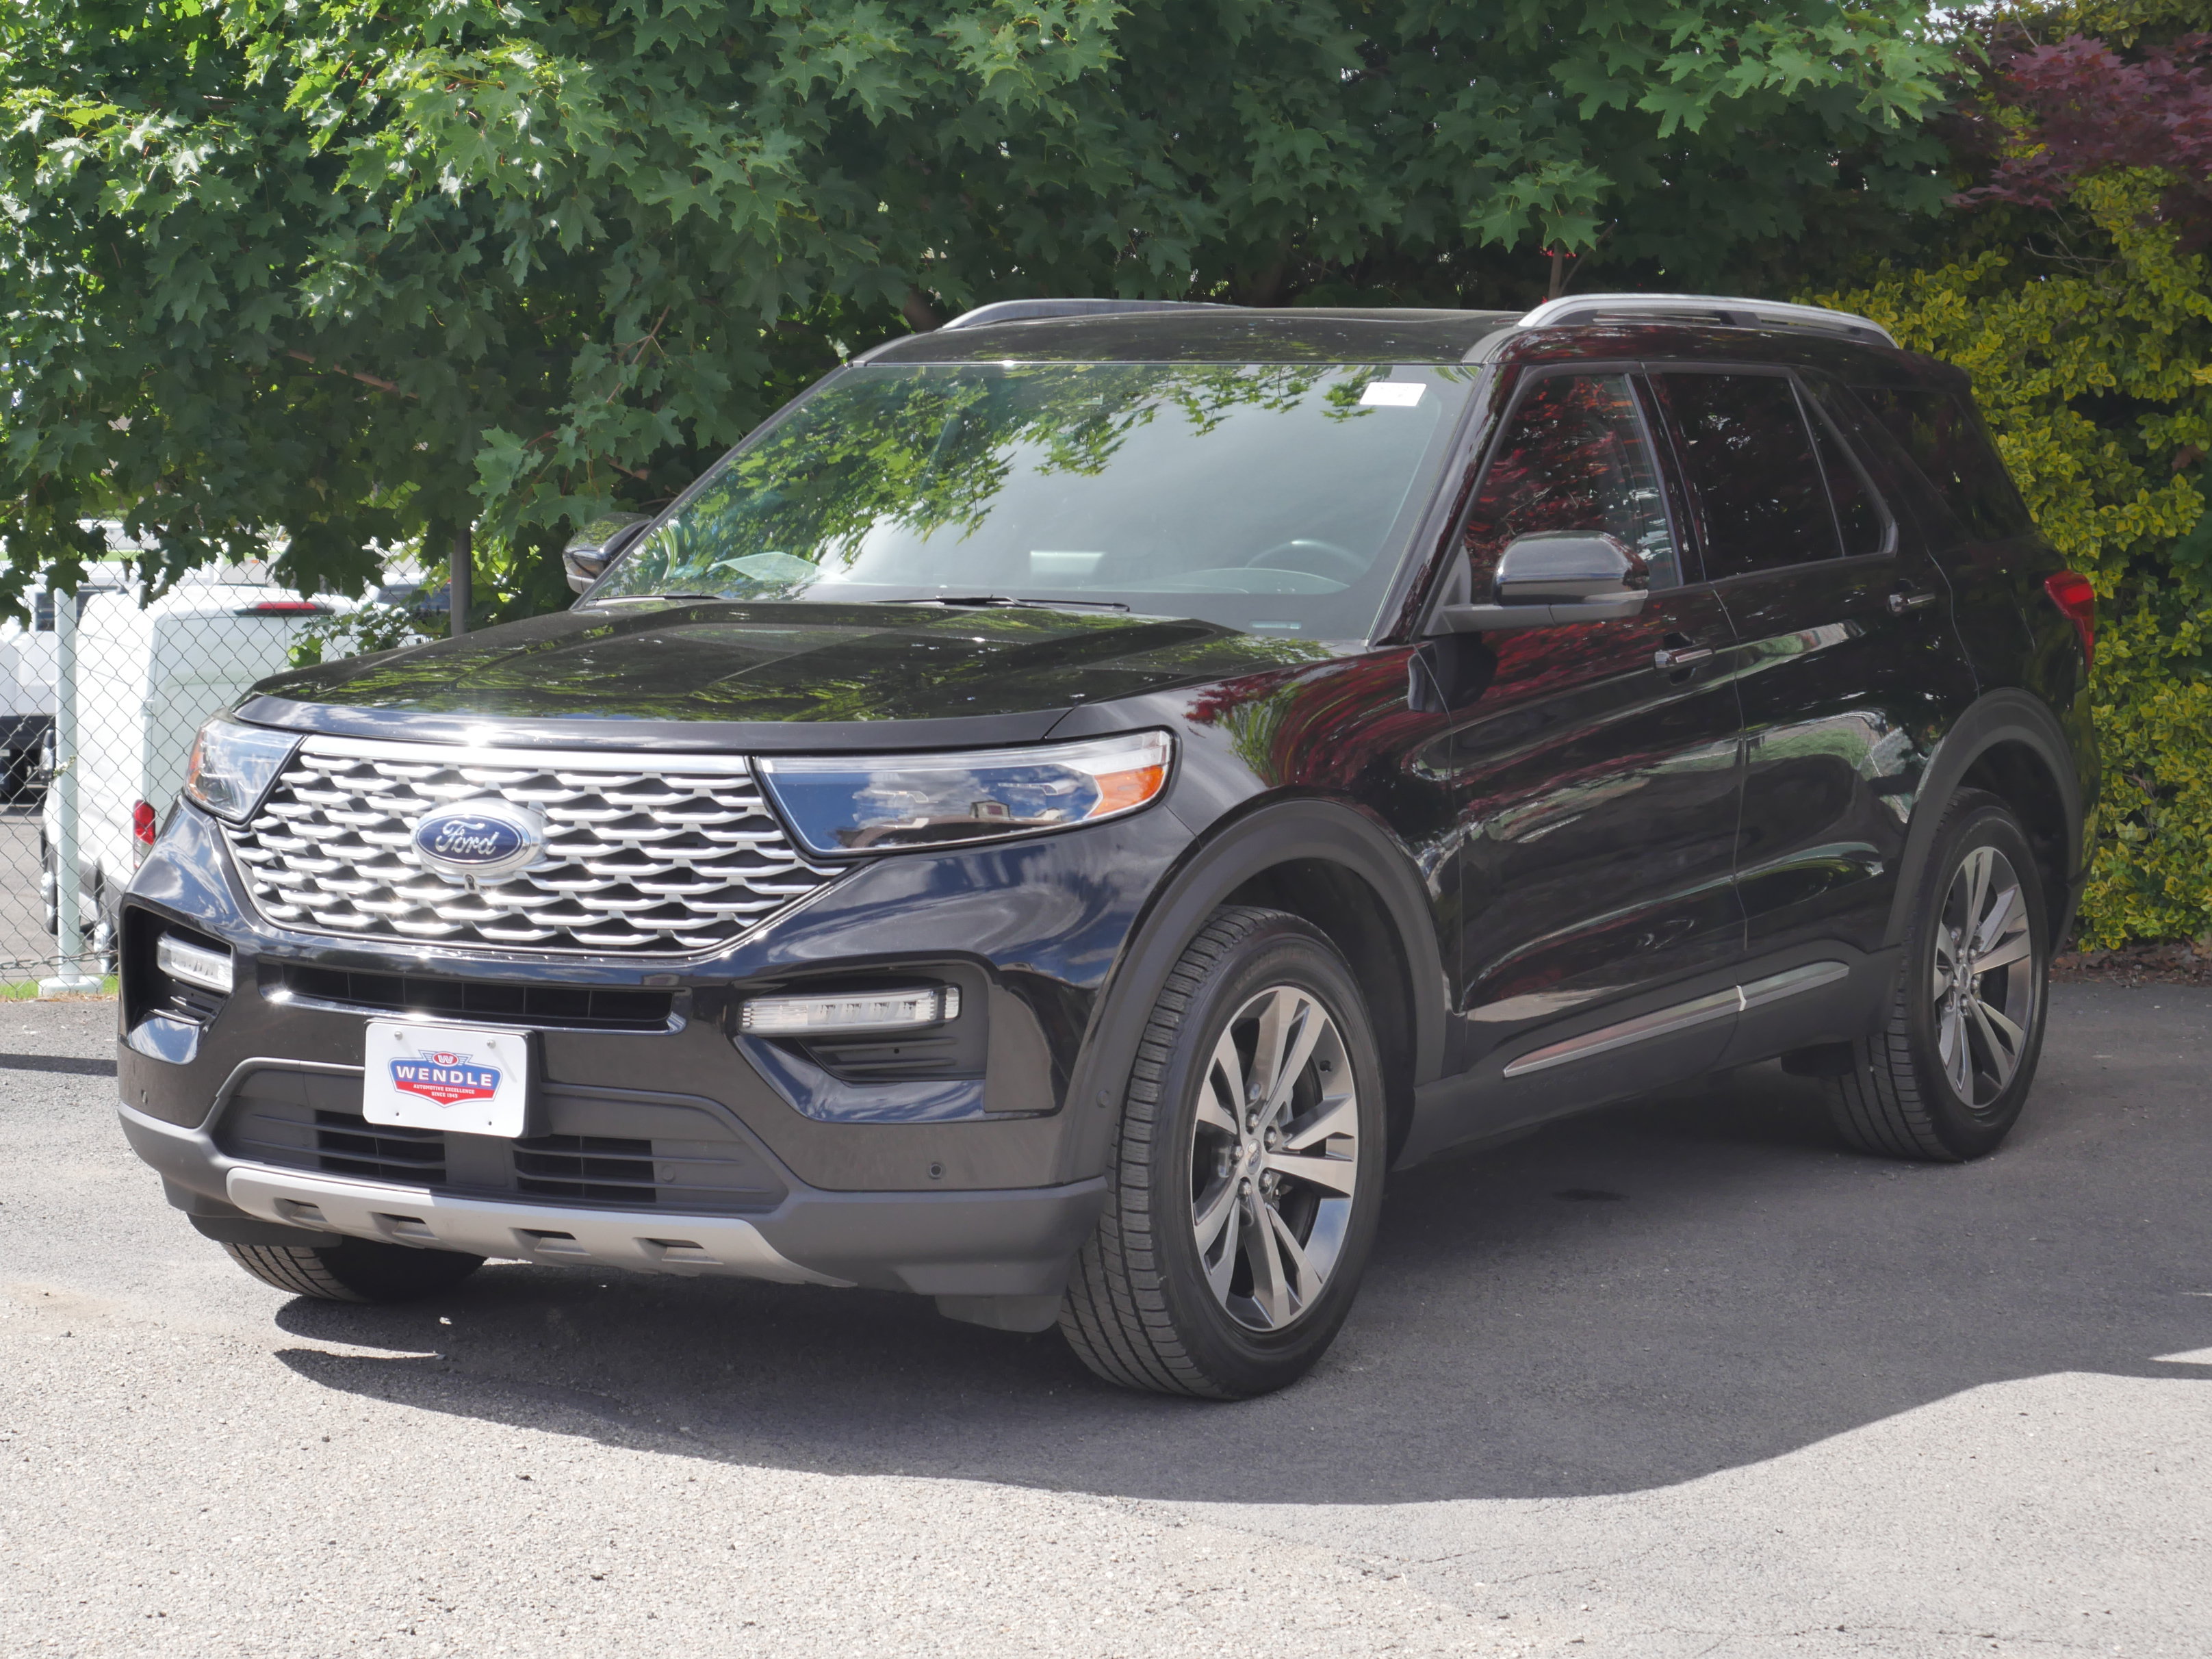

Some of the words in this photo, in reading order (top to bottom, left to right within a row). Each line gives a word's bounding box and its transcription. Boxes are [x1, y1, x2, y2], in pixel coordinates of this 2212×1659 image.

[435, 820, 500, 855] Ford
[437, 1055, 454, 1064] W
[396, 1066, 492, 1087] WENDLE
[413, 1083, 444, 1092] AUTOMOTIVE
[445, 1086, 475, 1094] EXCELLENCE
